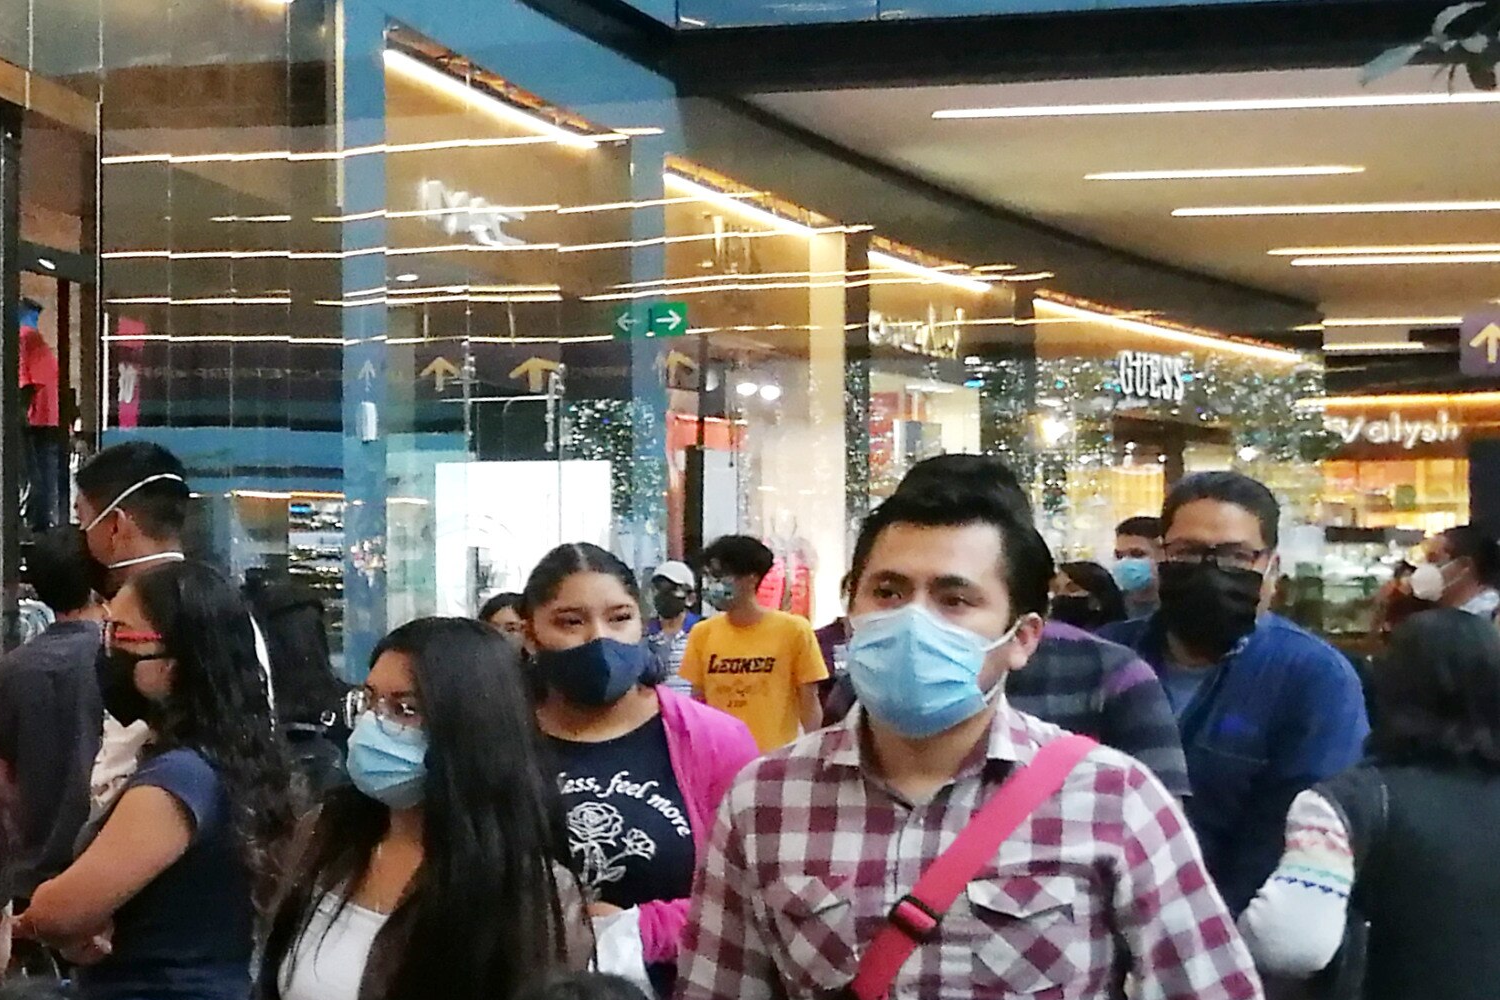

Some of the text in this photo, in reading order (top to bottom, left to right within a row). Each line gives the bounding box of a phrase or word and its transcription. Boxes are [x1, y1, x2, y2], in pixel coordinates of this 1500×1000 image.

[1119, 349, 1185, 401] GUESS
[596, 770, 660, 799] feel
[646, 793, 691, 838] more
